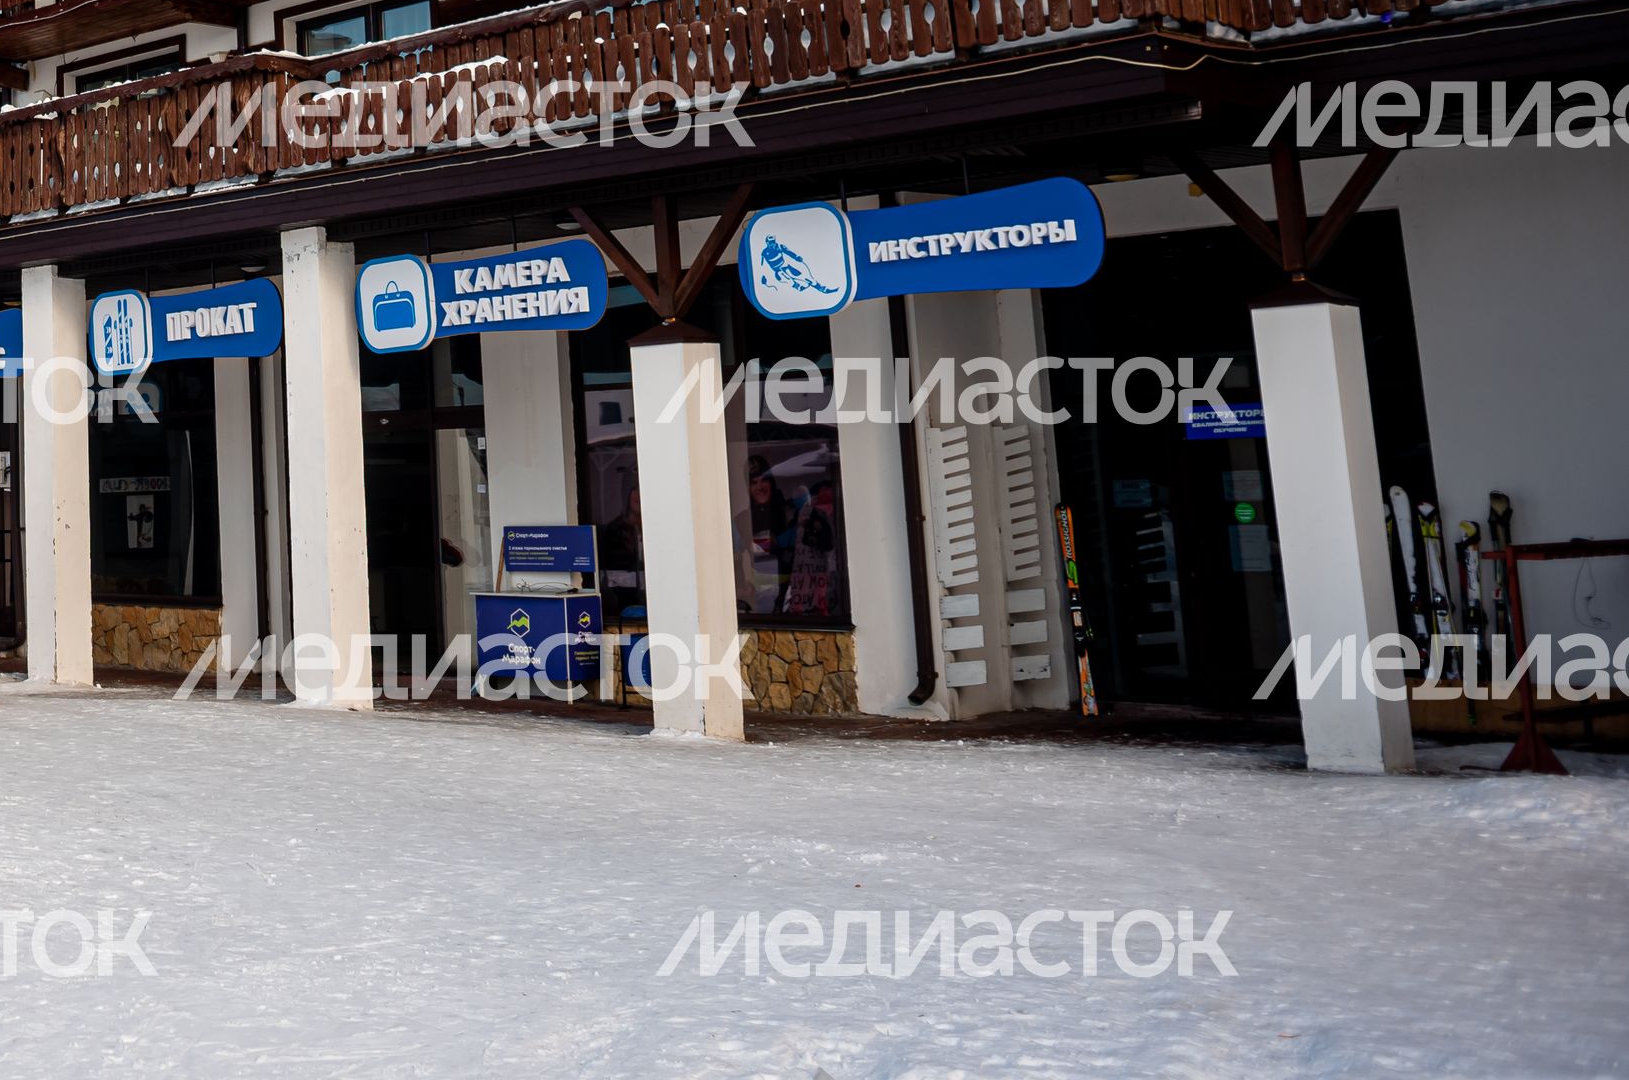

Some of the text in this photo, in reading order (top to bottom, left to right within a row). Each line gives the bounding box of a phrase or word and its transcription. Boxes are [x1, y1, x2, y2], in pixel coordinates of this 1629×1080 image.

[868, 219, 1077, 263] ИНСТРУКТОРЫ
[454, 257, 571, 295] КАМЕРА
[166, 302, 257, 341] ПРОКАТ
[440, 286, 591, 327] ХРАНЕНИЯ
